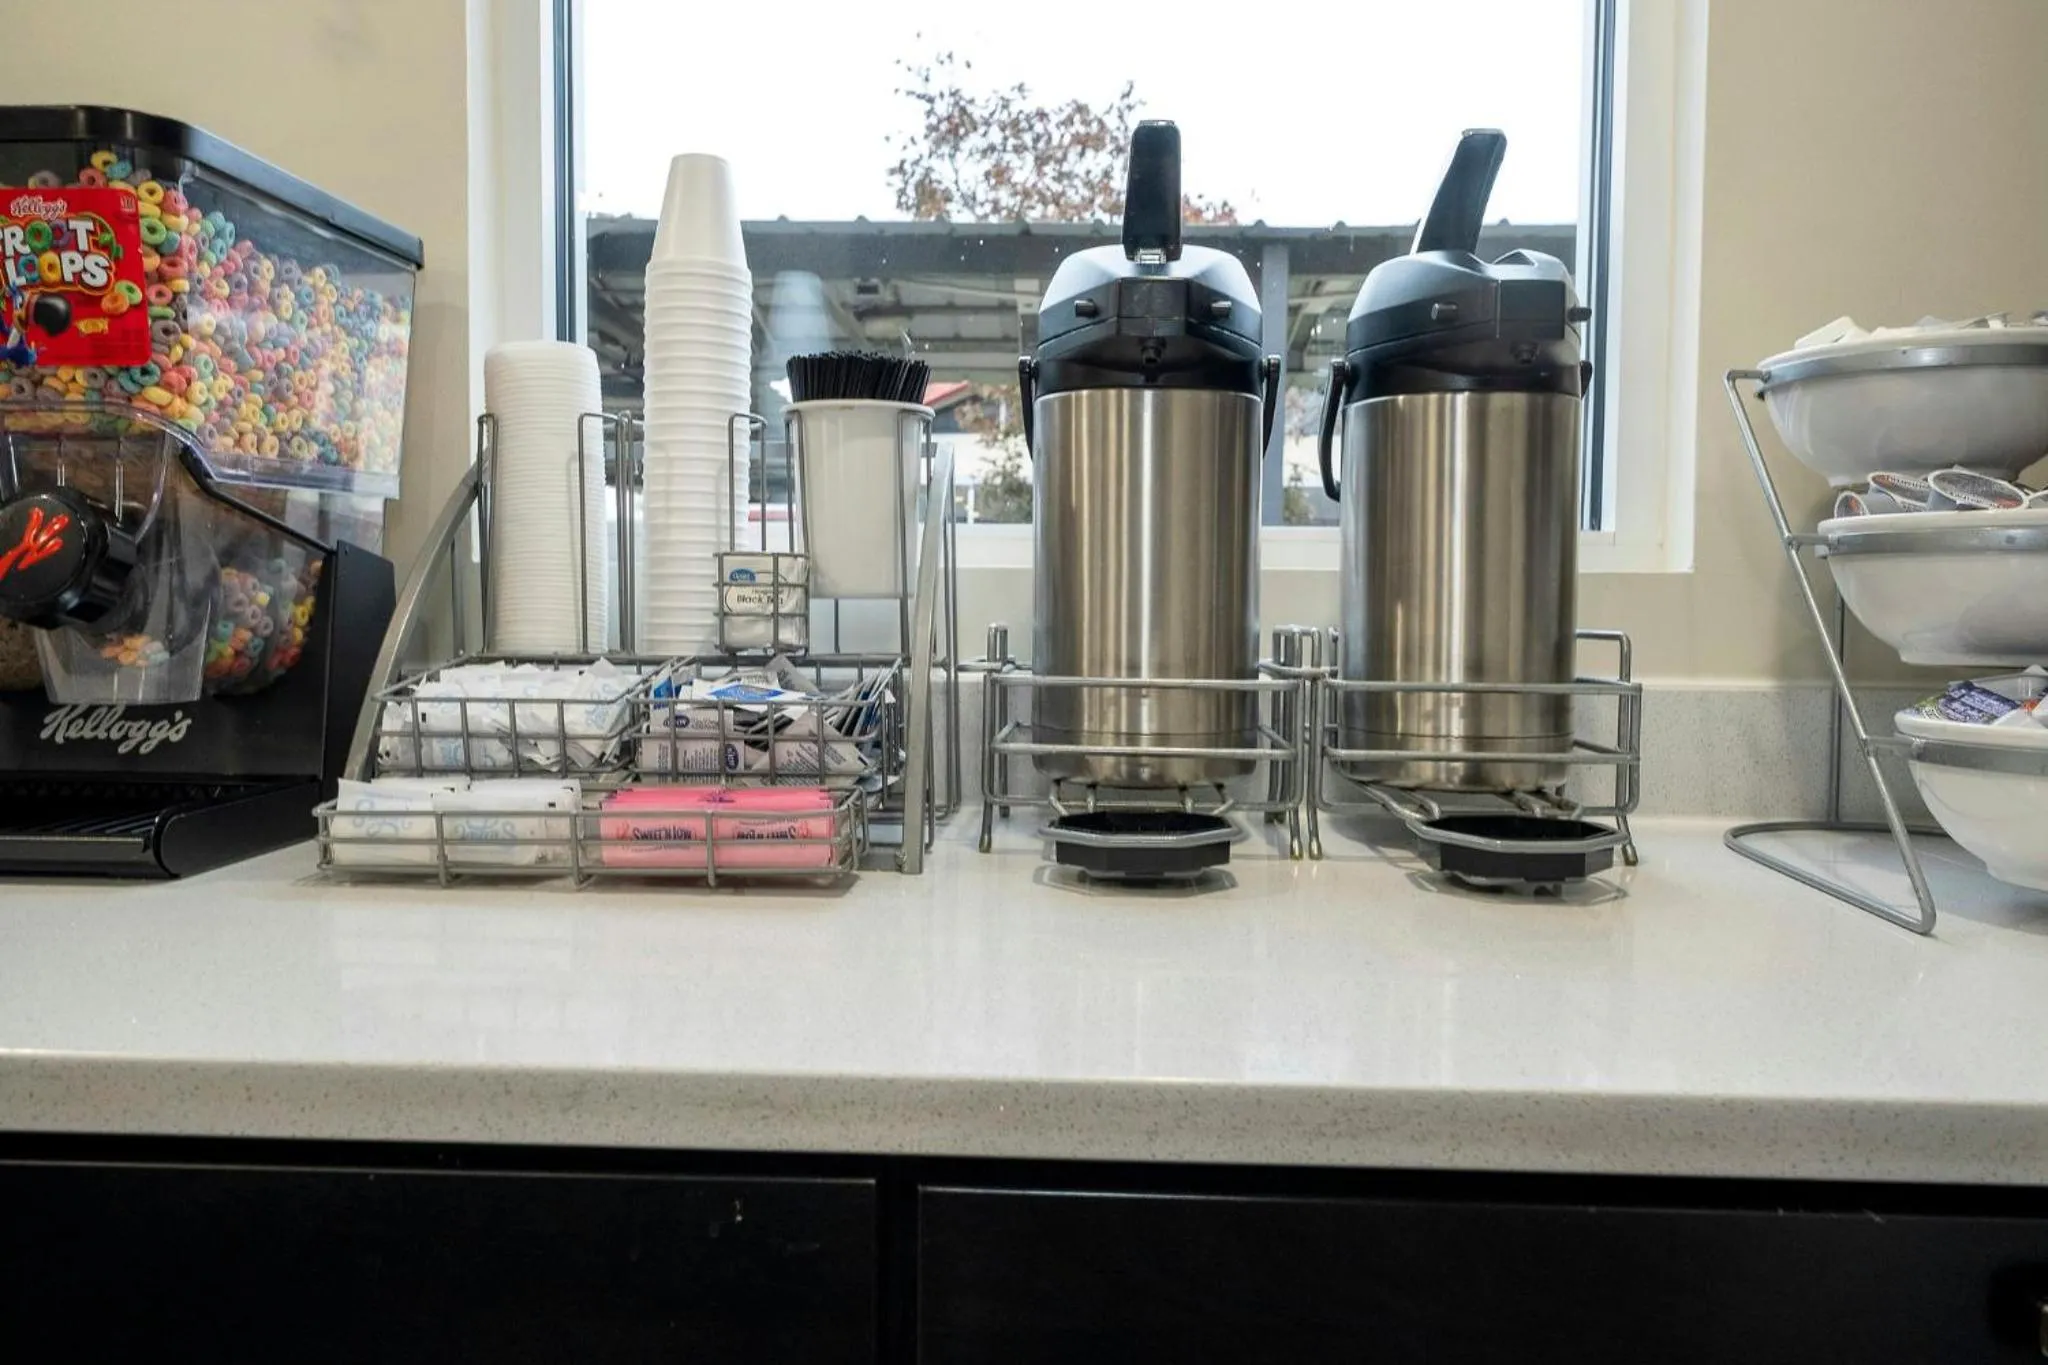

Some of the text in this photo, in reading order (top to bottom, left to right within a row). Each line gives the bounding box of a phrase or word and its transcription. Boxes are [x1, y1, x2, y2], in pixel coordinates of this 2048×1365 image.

[11, 196, 67, 219] Kellogg's
[0, 219, 94, 257] ROOT
[5, 251, 110, 287] LOOPS
[40, 702, 192, 754] Kellogg's
